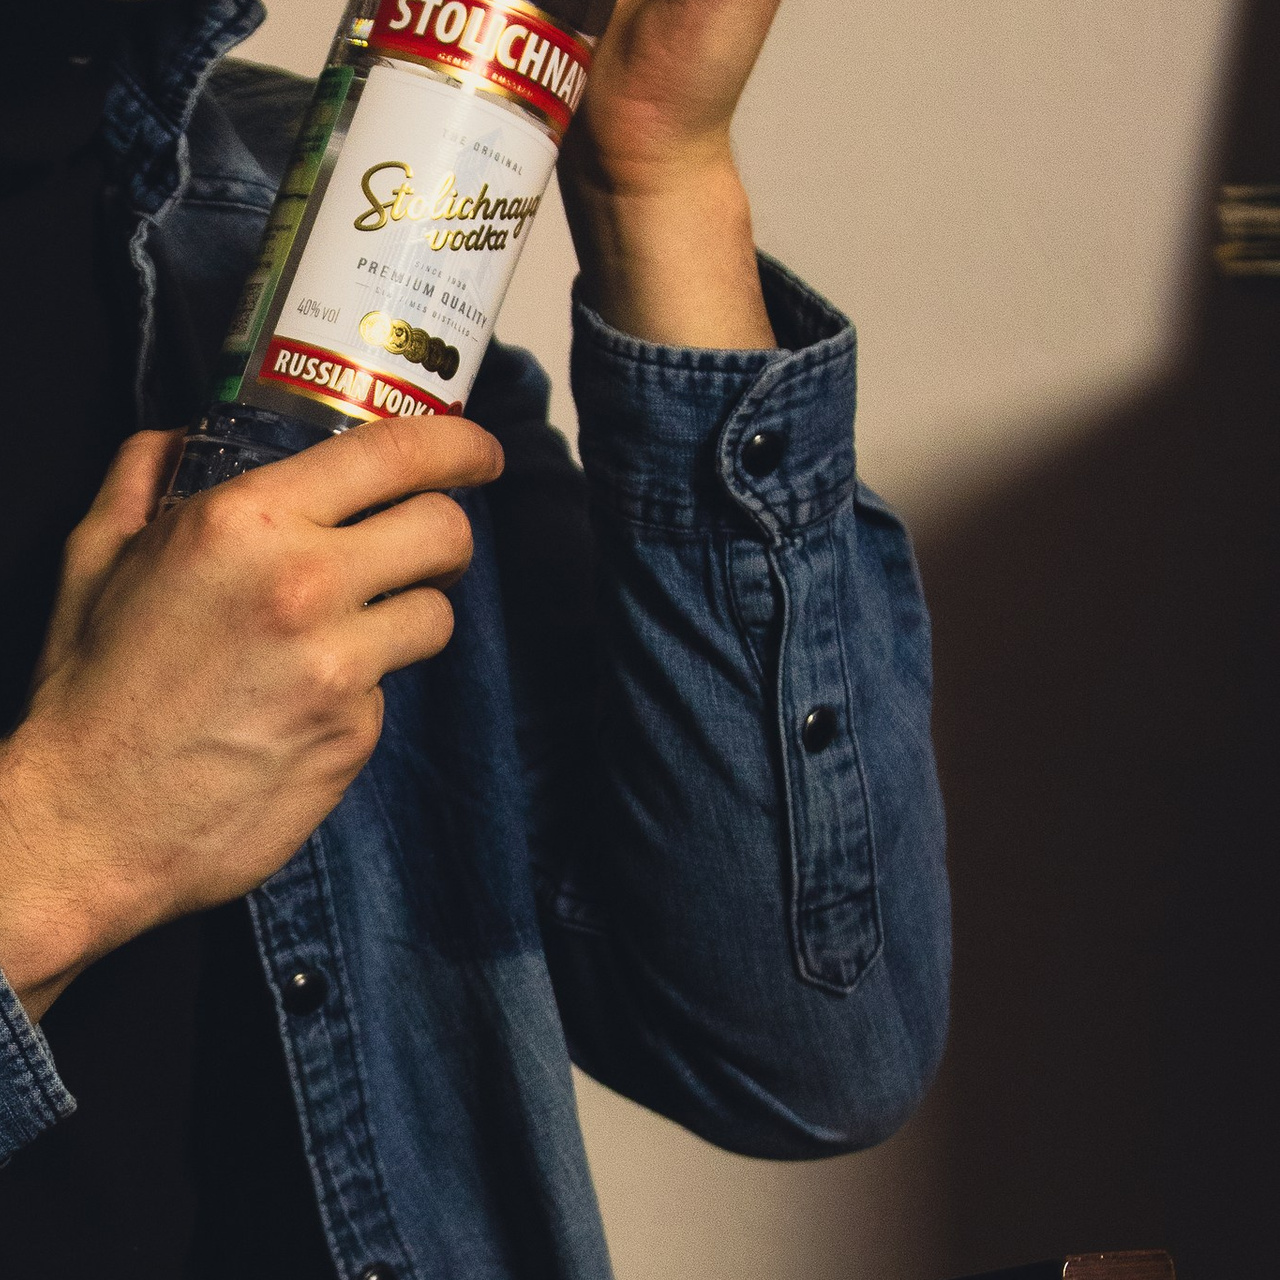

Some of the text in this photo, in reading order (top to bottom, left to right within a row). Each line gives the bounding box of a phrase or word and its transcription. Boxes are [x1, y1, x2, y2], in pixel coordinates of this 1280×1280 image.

[473, 141, 523, 176] ORIGINAL
[354, 161, 540, 238] Stolichnaya
[414, 261, 443, 278] SINCE
[297, 297, 341, 324] 40% vol
[356, 257, 488, 329] PREMIUM QUALITY
[274, 349, 373, 402] RUSSIAN
